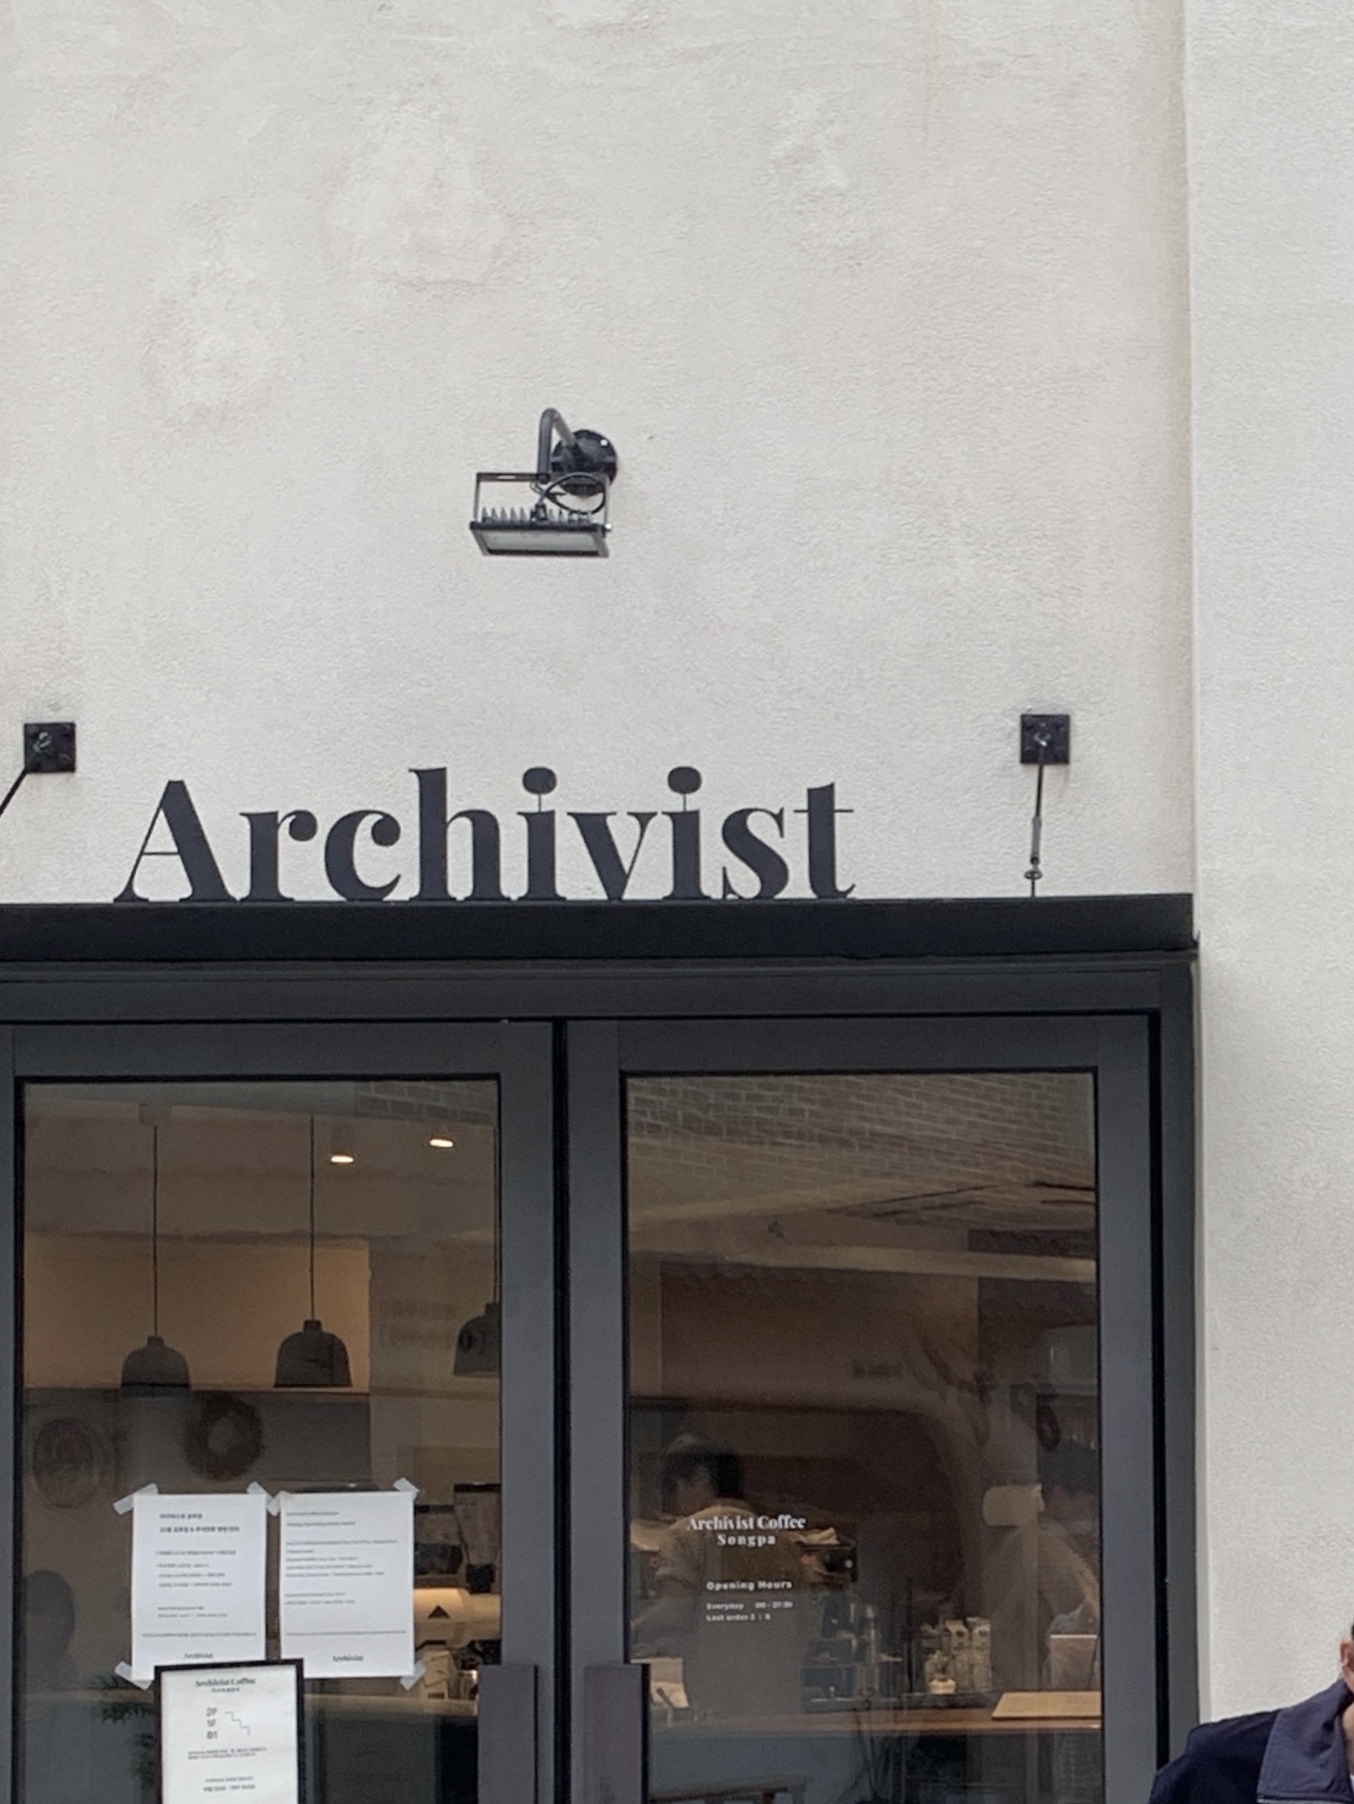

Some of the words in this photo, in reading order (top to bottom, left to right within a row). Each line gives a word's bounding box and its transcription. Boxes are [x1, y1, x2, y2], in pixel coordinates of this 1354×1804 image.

[113, 766, 856, 902] Archivist
[686, 1515, 755, 1531] Archivist
[757, 1514, 806, 1530] Coffee
[717, 1534, 776, 1547] Songpa
[706, 1581, 755, 1591] Opening
[757, 1581, 793, 1589] Hours
